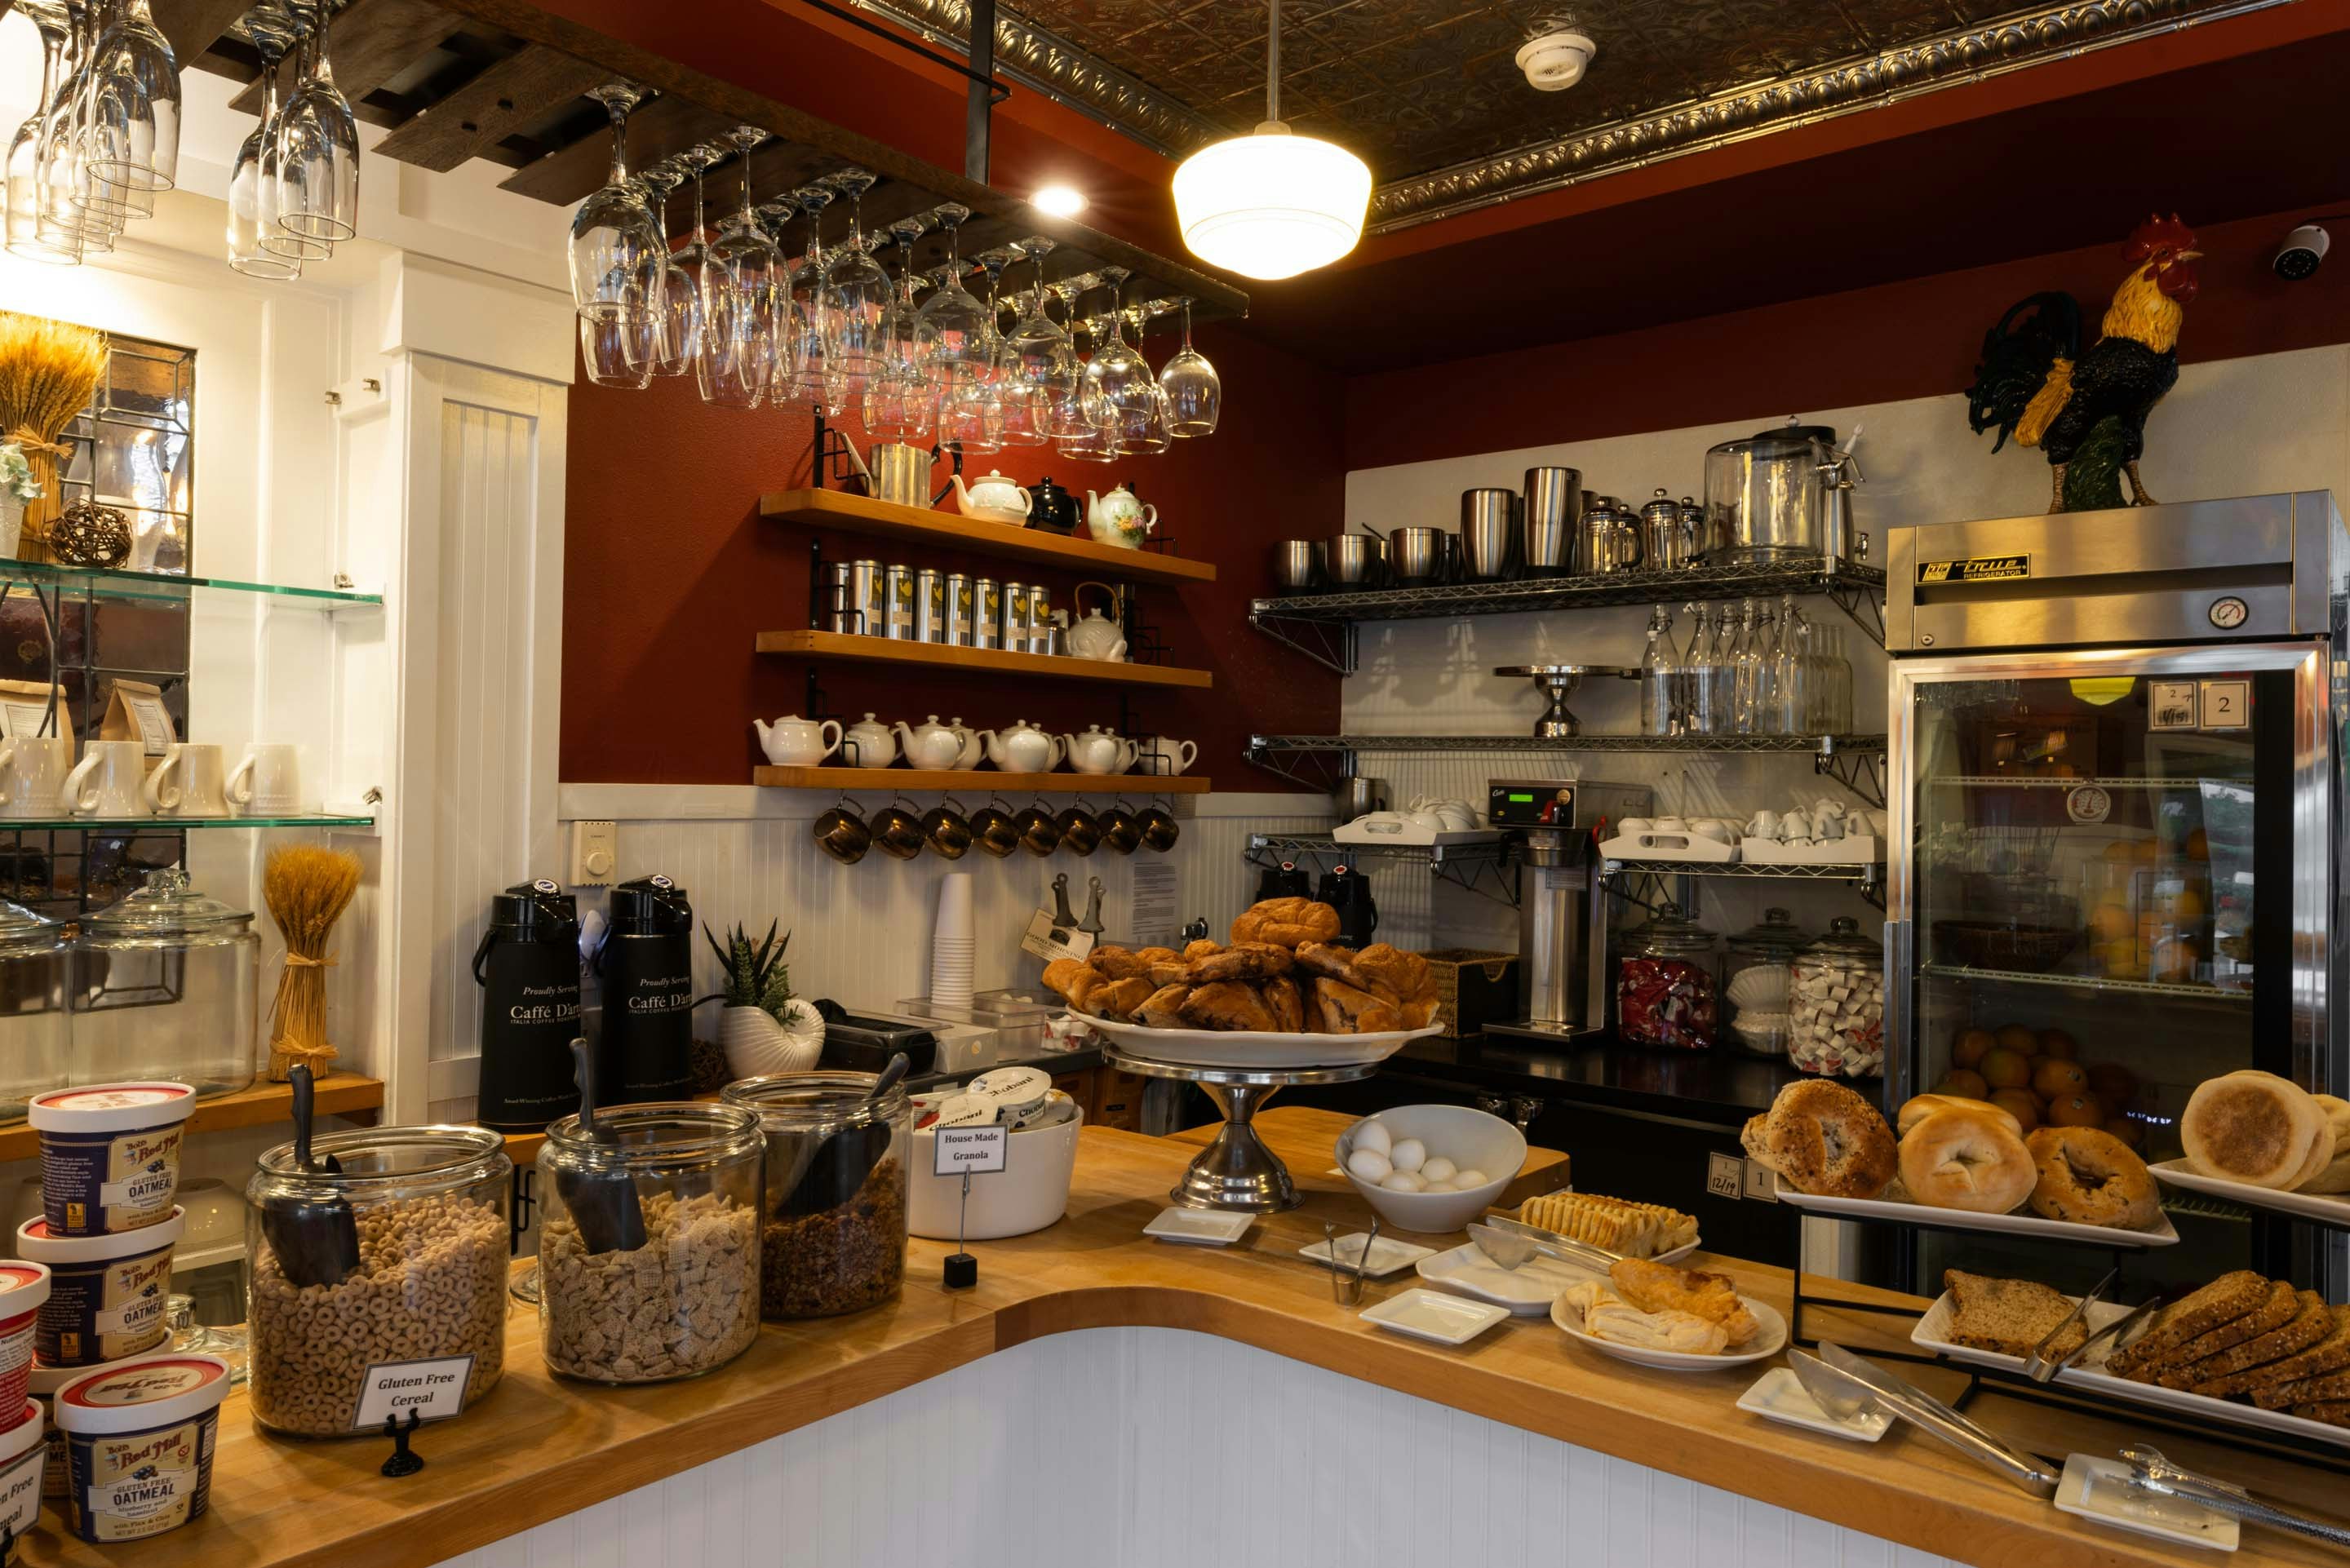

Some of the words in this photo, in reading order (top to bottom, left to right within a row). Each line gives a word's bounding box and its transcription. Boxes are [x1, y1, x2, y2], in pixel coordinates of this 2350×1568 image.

[1963, 570, 2021, 579] REFRIGERATOR
[2170, 689, 2177, 698] 2
[2219, 697, 2231, 712] 2
[640, 978, 669, 988] Proudly
[523, 986, 555, 997] Proudly
[628, 995, 666, 1008] Caffé
[510, 1005, 551, 1019] Caffé
[945, 1135, 973, 1144] House
[974, 1133, 998, 1141] Made
[138, 1141, 162, 1163] Red
[953, 1151, 989, 1160] Granola
[132, 1174, 157, 1185] GLUTEN
[1758, 1172, 1763, 1185] 1
[133, 1267, 157, 1291] Red
[124, 1300, 166, 1324] OATMEA
[378, 1377, 423, 1389] Gluten
[425, 1374, 455, 1385] Free
[391, 1392, 434, 1406] Cereal
[121, 1446, 151, 1470] Red
[150, 1431, 184, 1460] Mill
[11, 1476, 33, 1499] Free
[117, 1482, 148, 1494] GLUTEN
[149, 1477, 171, 1488] FREE
[113, 1483, 175, 1506] OATMEAL
